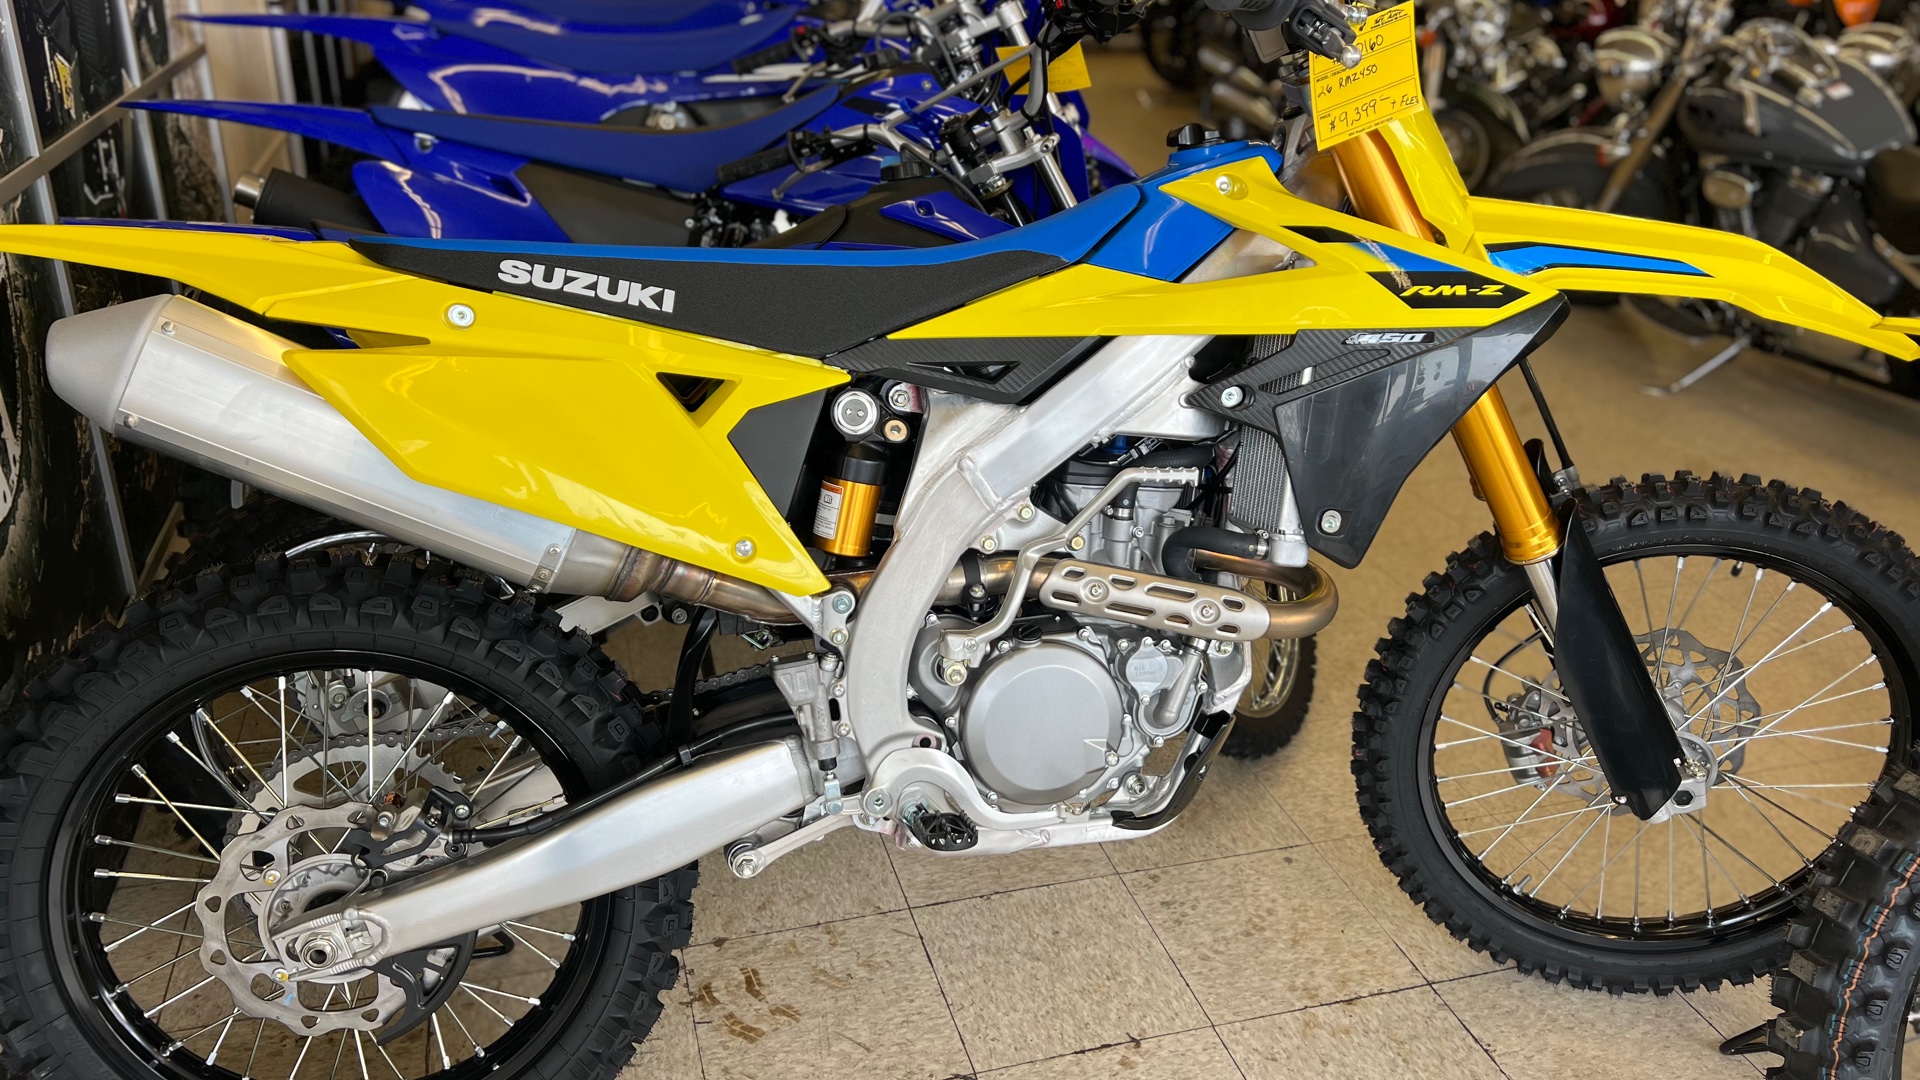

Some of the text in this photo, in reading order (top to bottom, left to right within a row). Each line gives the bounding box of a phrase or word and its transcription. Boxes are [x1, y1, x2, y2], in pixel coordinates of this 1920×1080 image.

[497, 259, 676, 313] SUZUKI
[1399, 284, 1505, 297] RM-Z
[1357, 332, 1428, 344] 450
